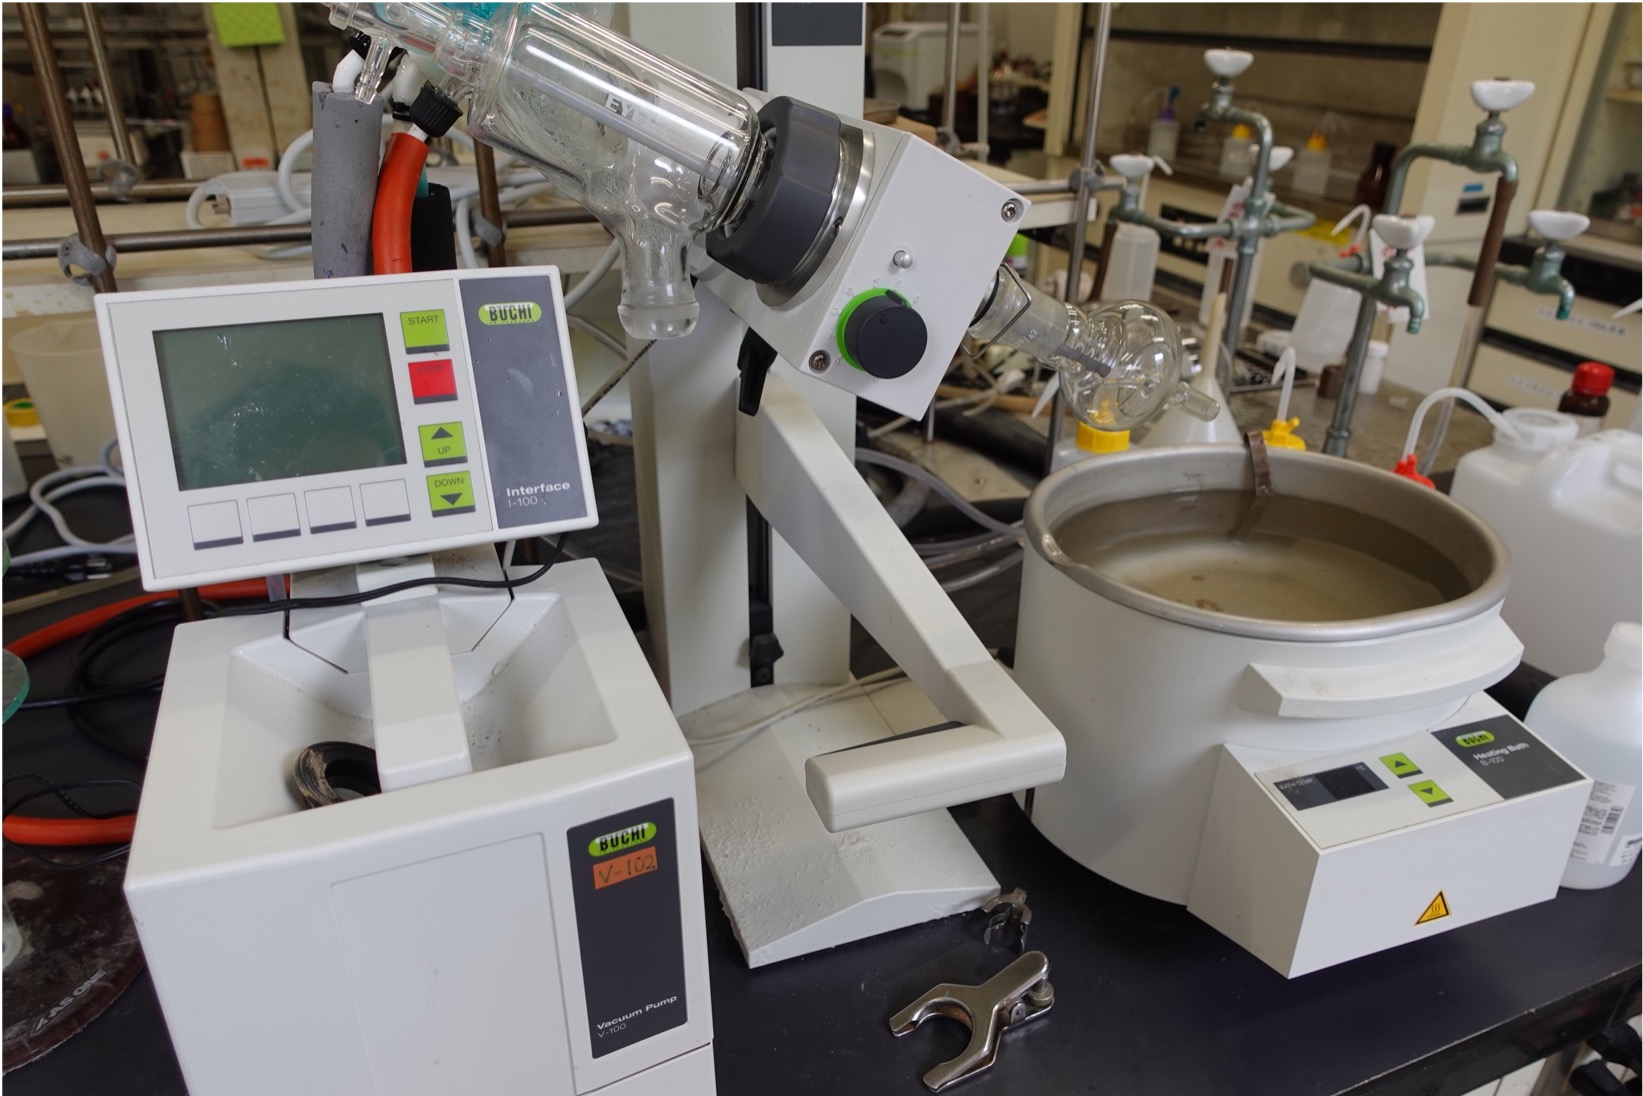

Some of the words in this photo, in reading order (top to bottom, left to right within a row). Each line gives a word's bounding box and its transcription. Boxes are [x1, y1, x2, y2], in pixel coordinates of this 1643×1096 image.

[408, 314, 439, 326] START
[437, 445, 451, 455] UP
[434, 476, 465, 488] DOWN
[506, 481, 571, 497] Interface
[1473, 748, 1510, 760] Heating
[1506, 742, 1530, 752] Bath
[598, 854, 657, 884] V-102
[596, 1008, 643, 1030] Vacuum
[645, 995, 678, 1012] Pump
[597, 1022, 627, 1038] V-100
